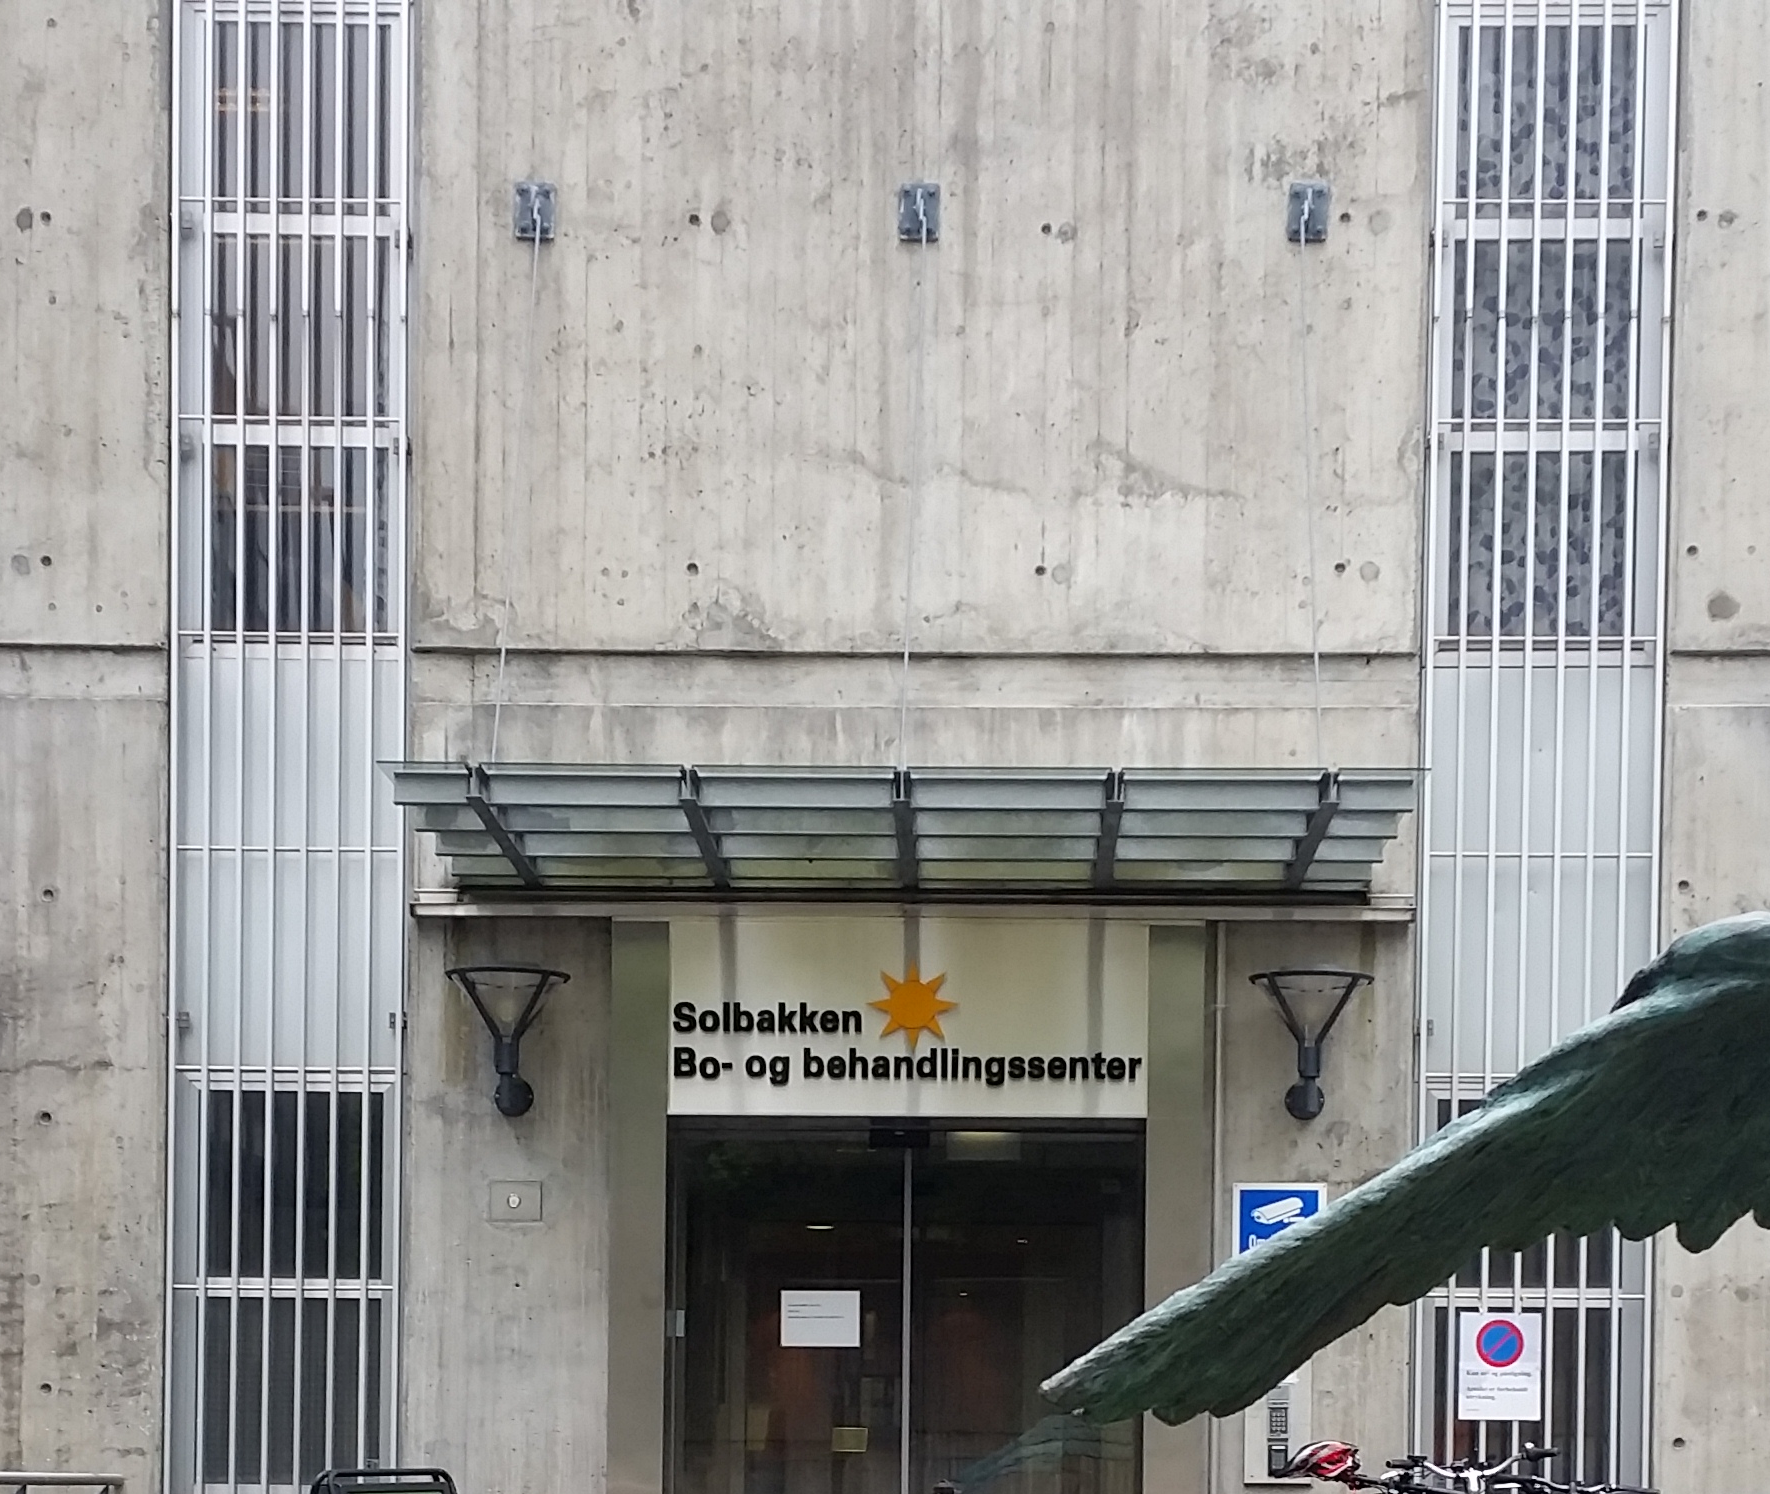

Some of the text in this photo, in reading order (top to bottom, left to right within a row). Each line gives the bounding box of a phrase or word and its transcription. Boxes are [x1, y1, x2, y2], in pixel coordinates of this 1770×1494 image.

[672, 1001, 863, 1034] Solbakken
[672, 1047, 1143, 1087] Bo- og behandlingssenter
